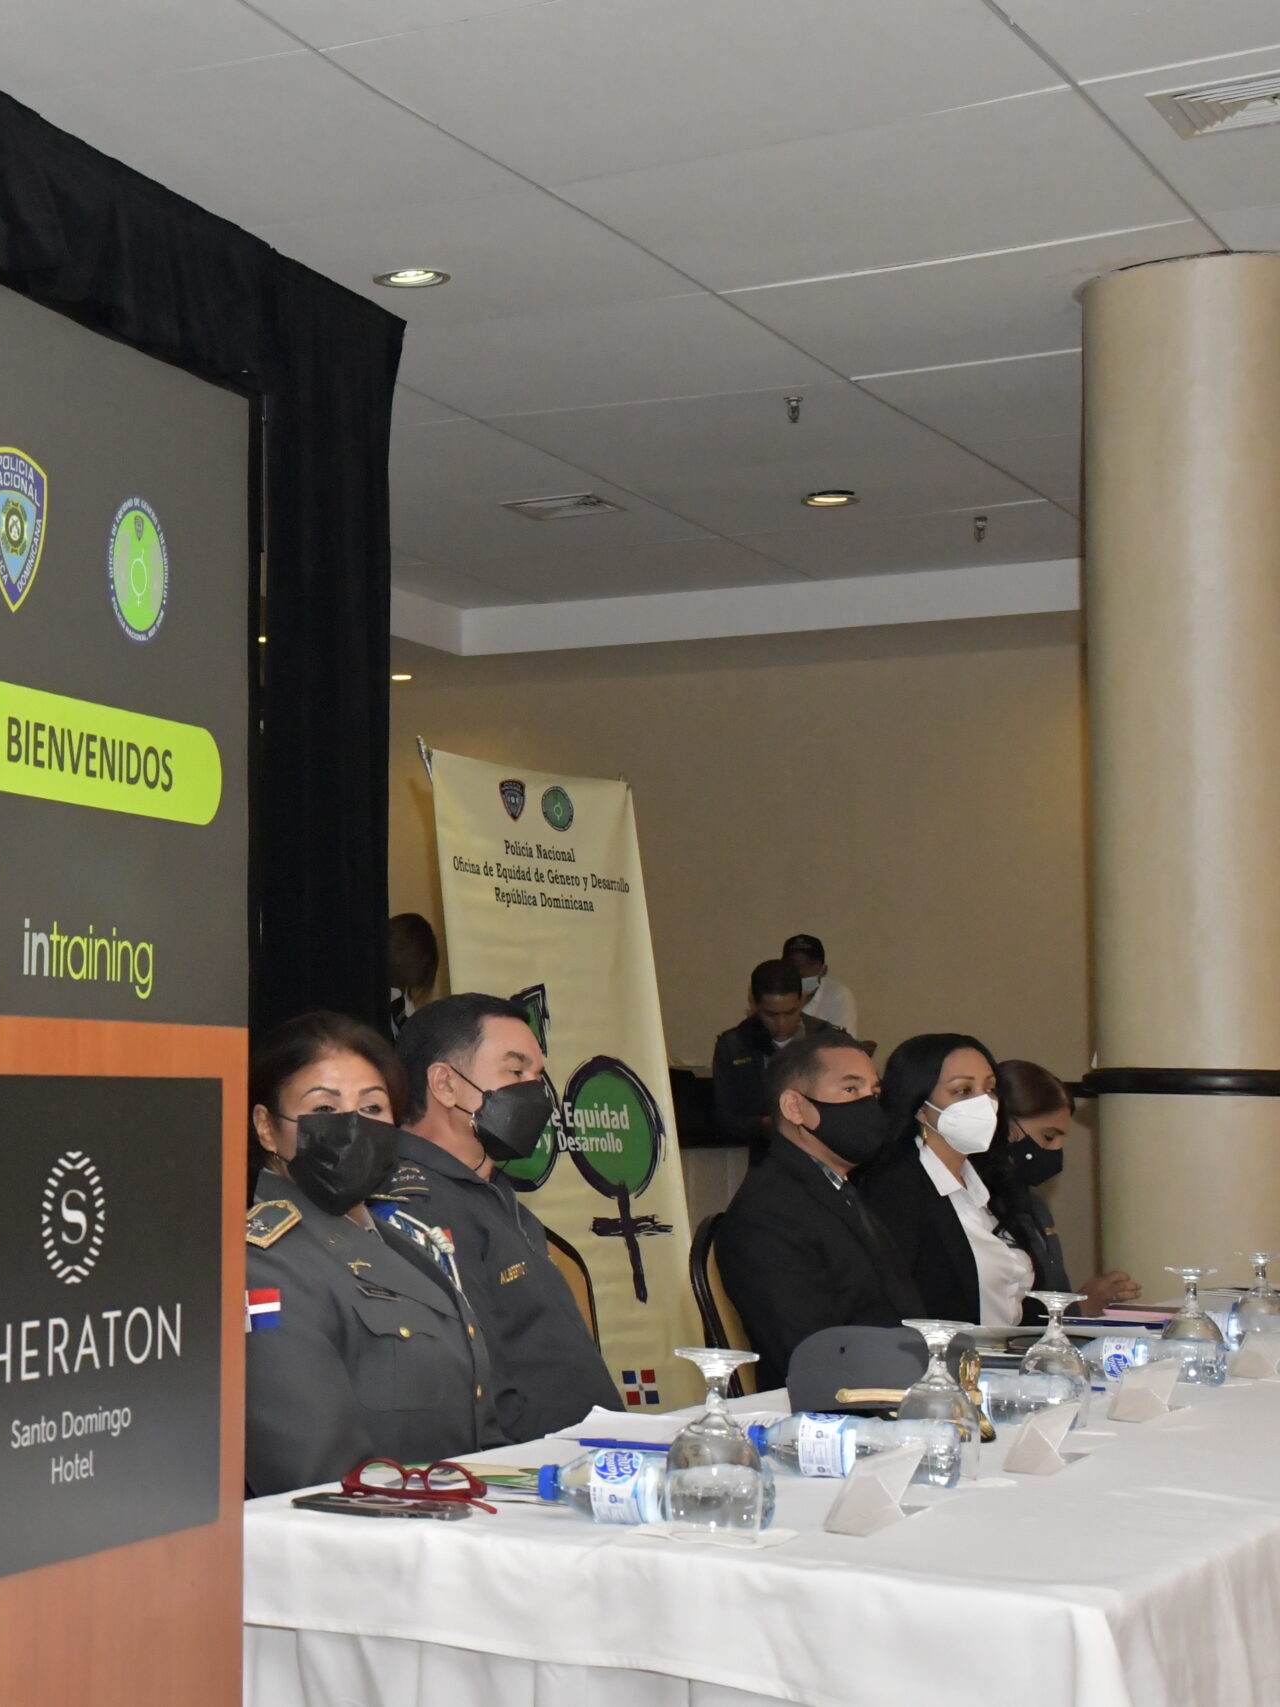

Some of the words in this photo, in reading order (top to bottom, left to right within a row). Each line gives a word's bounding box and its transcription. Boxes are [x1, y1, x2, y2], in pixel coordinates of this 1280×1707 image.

[17, 519, 42, 592] DOMINICANA
[7, 716, 173, 792] BIENVENIDOS
[536, 844, 576, 862] Nacional
[453, 855, 480, 875] Oficina
[483, 861, 494, 876] de
[496, 863, 532, 883] Equidad
[534, 867, 545, 883] de
[547, 869, 580, 887] Género
[582, 876, 588, 891] y
[590, 873, 630, 893] Desarrollo
[494, 886, 538, 908] República
[540, 892, 594, 912] Dominicana
[23, 918, 153, 999] intraining
[547, 1107, 561, 1127] e
[563, 1101, 630, 1134] Equidad
[542, 1133, 552, 1154] y
[557, 1131, 623, 1152] Desarrollo
[10, 1415, 57, 1449] Santo
[62, 1405, 132, 1437] Domingo
[51, 1450, 94, 1484] Hotel
